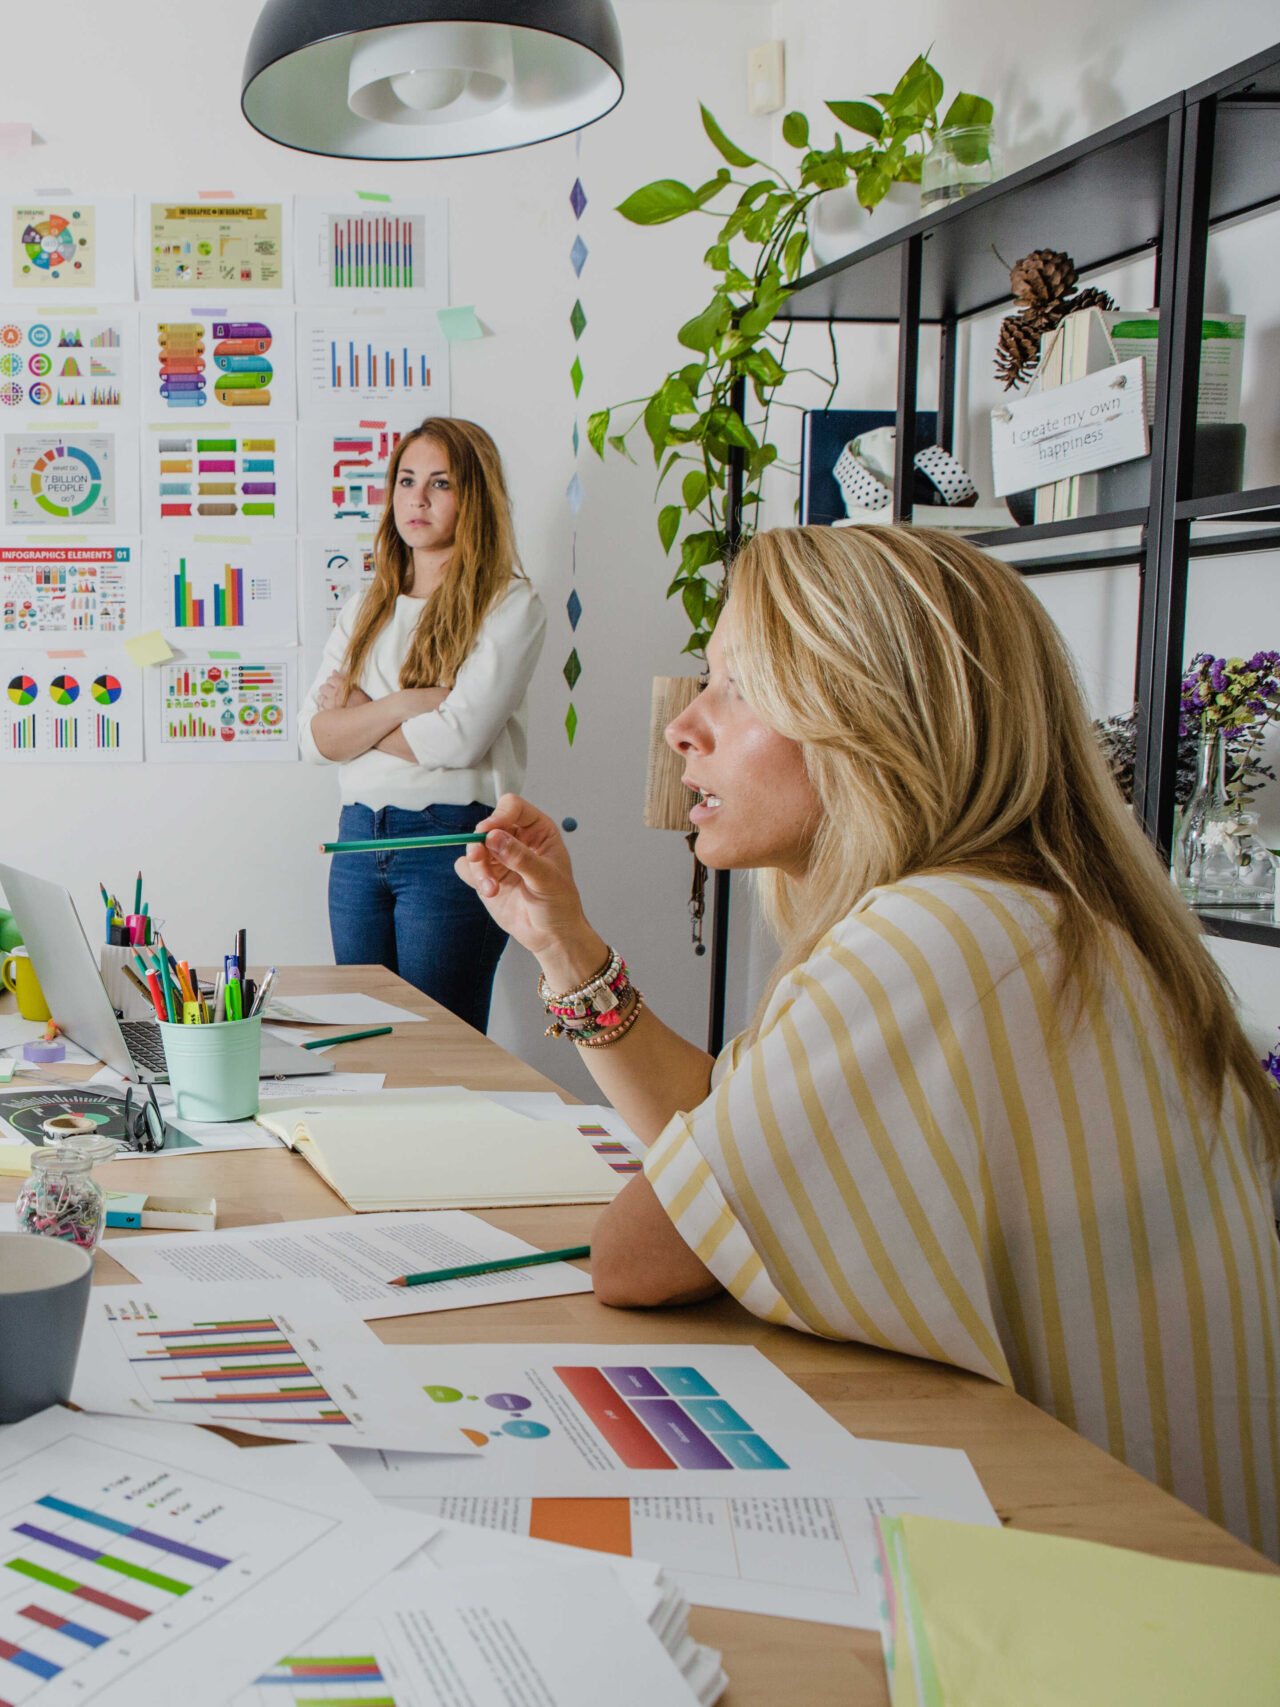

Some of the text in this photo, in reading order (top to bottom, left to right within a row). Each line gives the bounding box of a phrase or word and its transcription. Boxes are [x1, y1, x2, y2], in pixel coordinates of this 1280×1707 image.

[216, 326, 224, 337] A
[220, 358, 226, 368] C
[1020, 417, 1060, 442] create
[1063, 409, 1086, 427] my
[1089, 396, 1121, 417] own
[1038, 429, 1105, 461] happiness
[44, 475, 88, 484] 7 BILLION
[47, 483, 85, 492] PEOPLE
[1, 550, 128, 560] INFOGRAPHICS ELEMENTS 01
